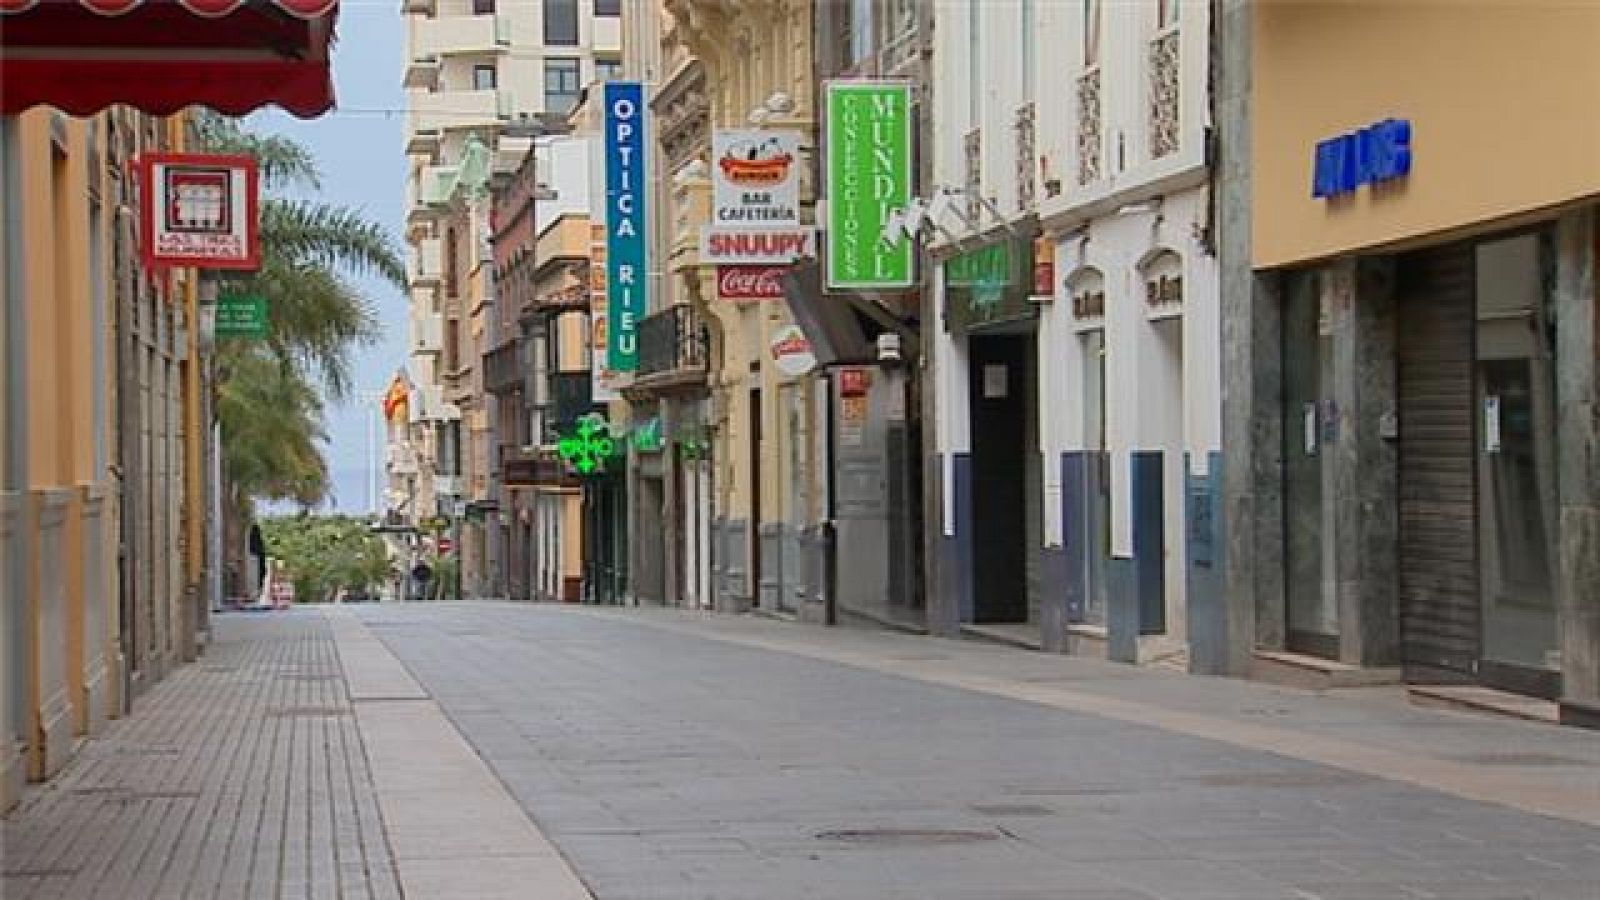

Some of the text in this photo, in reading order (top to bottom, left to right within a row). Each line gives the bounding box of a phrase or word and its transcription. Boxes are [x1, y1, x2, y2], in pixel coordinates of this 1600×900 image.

[741, 191, 772, 204] BAR
[613, 99, 637, 354] OPTICA RIEU
[708, 233, 808, 256] SNUUPY
